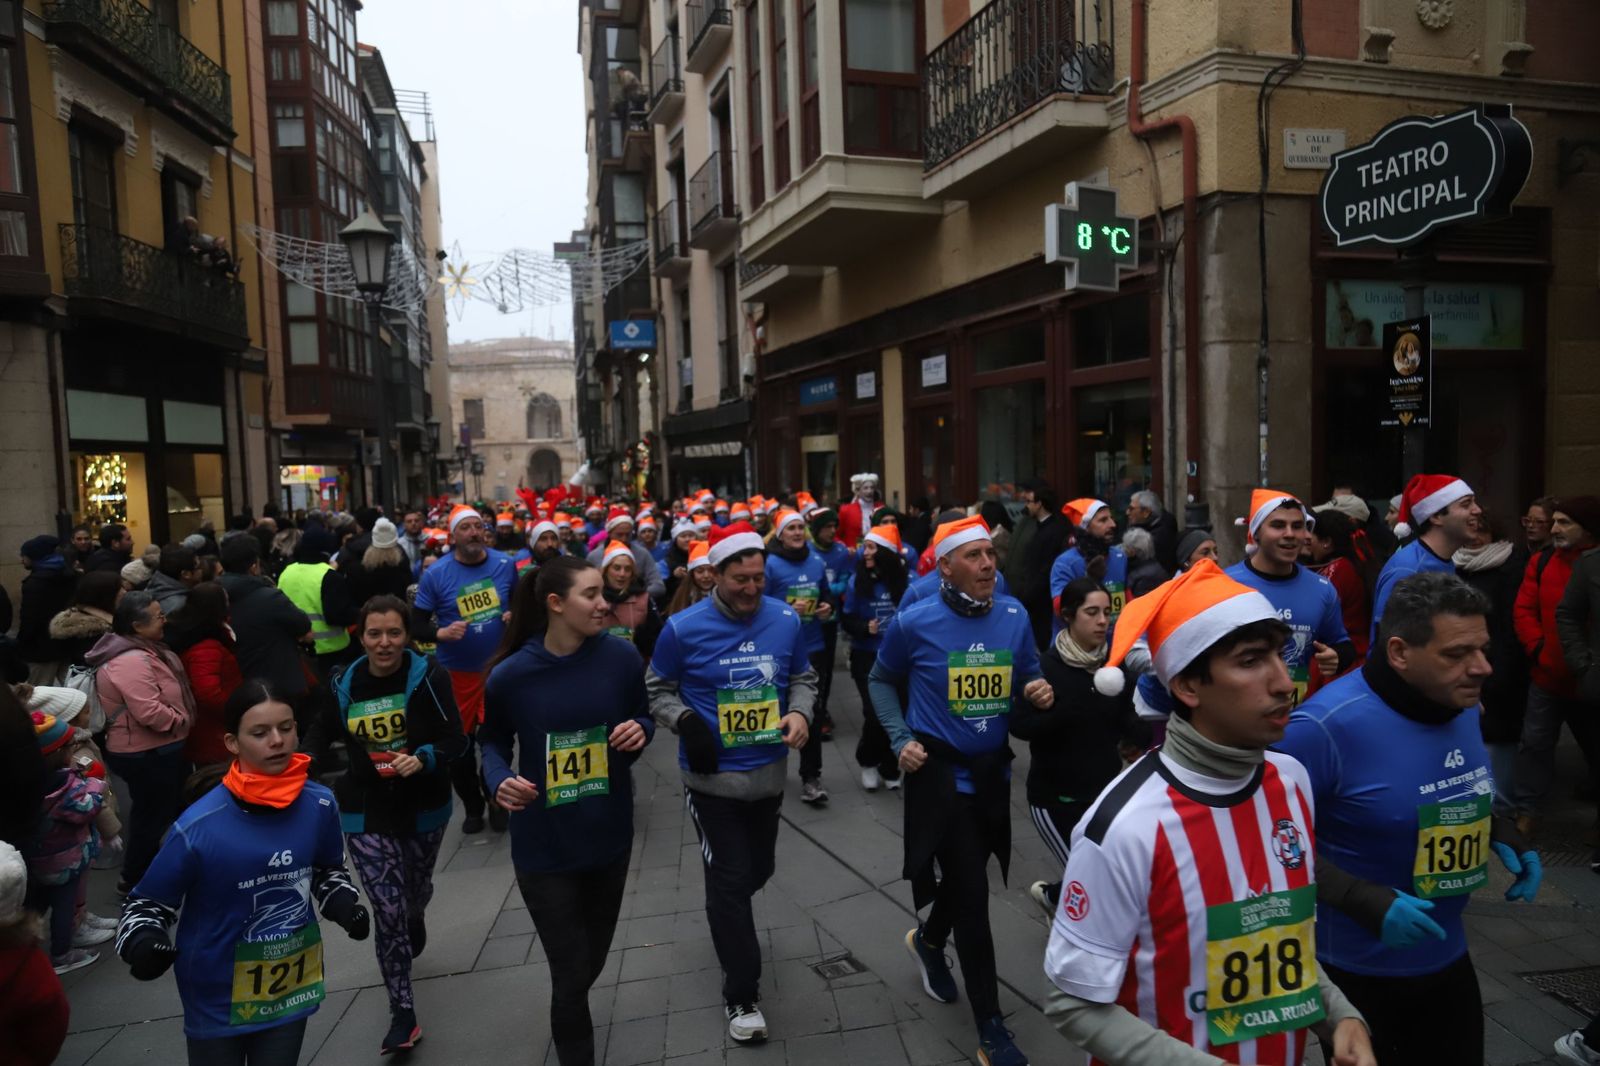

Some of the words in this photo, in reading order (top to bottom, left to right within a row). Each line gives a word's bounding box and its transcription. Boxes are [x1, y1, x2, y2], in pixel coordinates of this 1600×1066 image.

[1306, 135, 1331, 143] CALLE
[1311, 145, 1321, 153] DE
[1357, 141, 1449, 187] TEATRO
[1345, 175, 1467, 227] PRINCIPAL
[1078, 223, 1092, 250] 8
[1101, 226, 1131, 254] °C
[1433, 291, 1445, 304] la
[1446, 291, 1480, 304] salud
[462, 591, 492, 612] 1188
[738, 641, 755, 653] 46
[968, 642, 985, 652] 46
[953, 673, 1002, 699] 1308
[967, 703, 985, 711] CAJA
[355, 713, 406, 739] 459
[723, 708, 770, 732] 1267
[548, 748, 591, 782] 141
[1444, 748, 1465, 769] 46
[1419, 782, 1436, 795] SAN
[1436, 770, 1474, 790] SILVESTRE
[267, 850, 293, 868] 46
[1424, 830, 1481, 873] 1301
[238, 879, 255, 889] SAN
[256, 870, 299, 885] SILVESTRE
[1438, 877, 1463, 890] CAJA
[246, 953, 306, 995] 121
[1221, 938, 1303, 1004] 818
[259, 1000, 283, 1015] CAJA
[286, 988, 320, 1007] RURAL
[1243, 1010, 1278, 1027] CAJA
[1280, 998, 1320, 1021] RURAL
